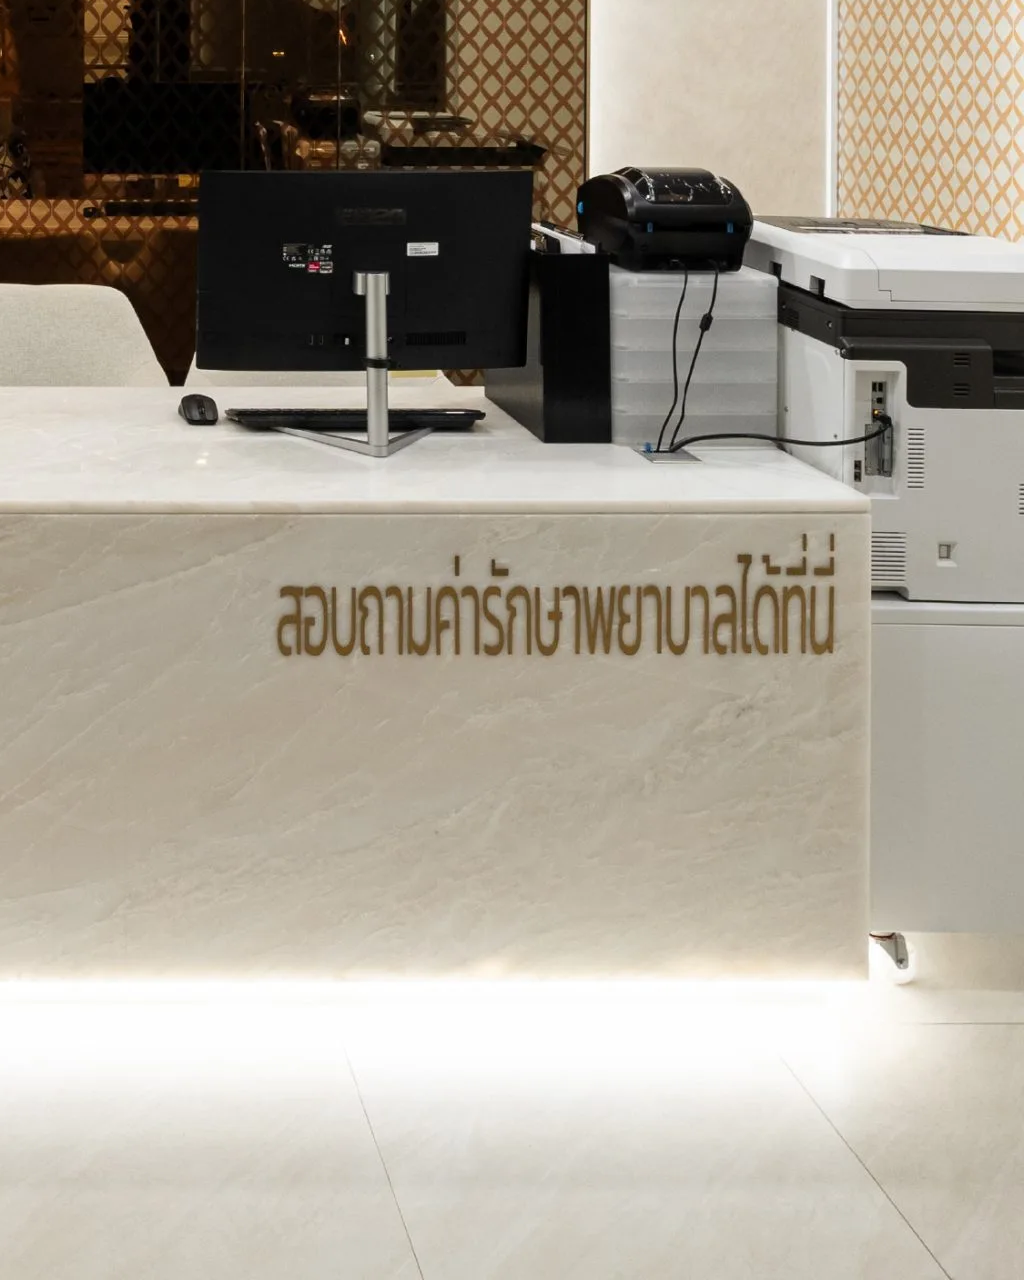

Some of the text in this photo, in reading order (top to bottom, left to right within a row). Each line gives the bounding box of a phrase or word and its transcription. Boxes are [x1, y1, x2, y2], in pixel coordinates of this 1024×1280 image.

[277, 532, 835, 656] สอบถามค่ารักษาพยาบาลได้ที่นี่
